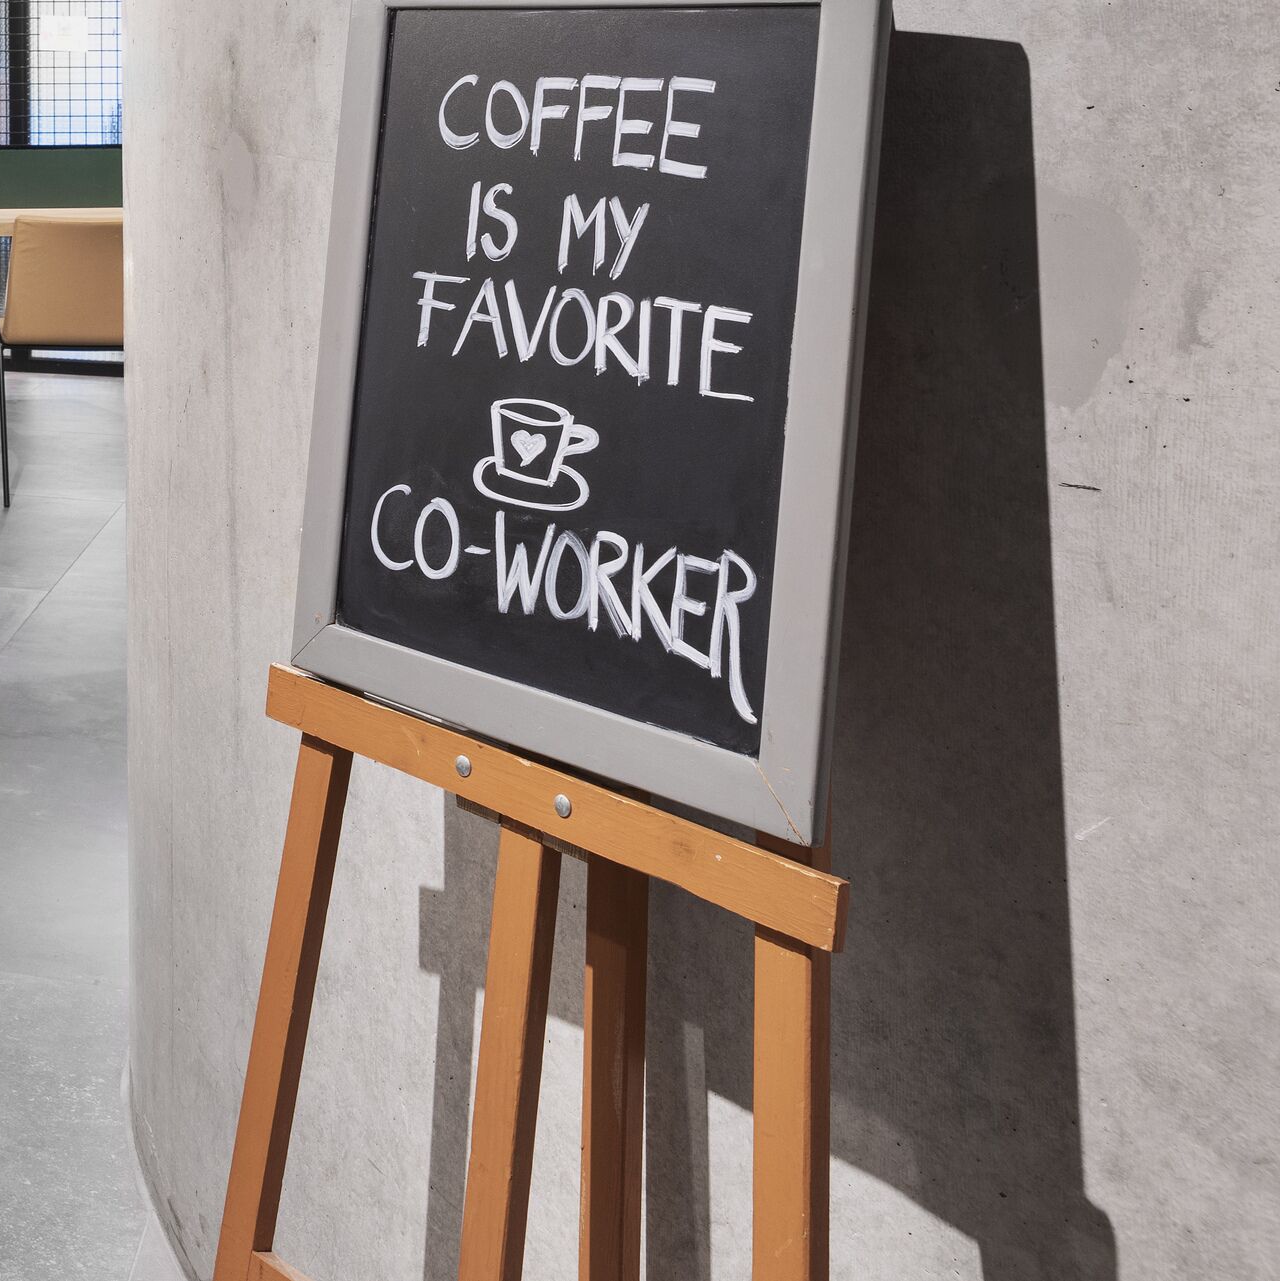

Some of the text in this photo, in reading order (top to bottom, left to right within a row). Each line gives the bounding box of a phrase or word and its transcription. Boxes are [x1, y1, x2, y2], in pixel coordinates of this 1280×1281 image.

[437, 72, 717, 179] COFFEE
[465, 180, 650, 281] IS MY
[412, 270, 755, 403] FAVORITE
[370, 483, 758, 725] CO-WORKER
